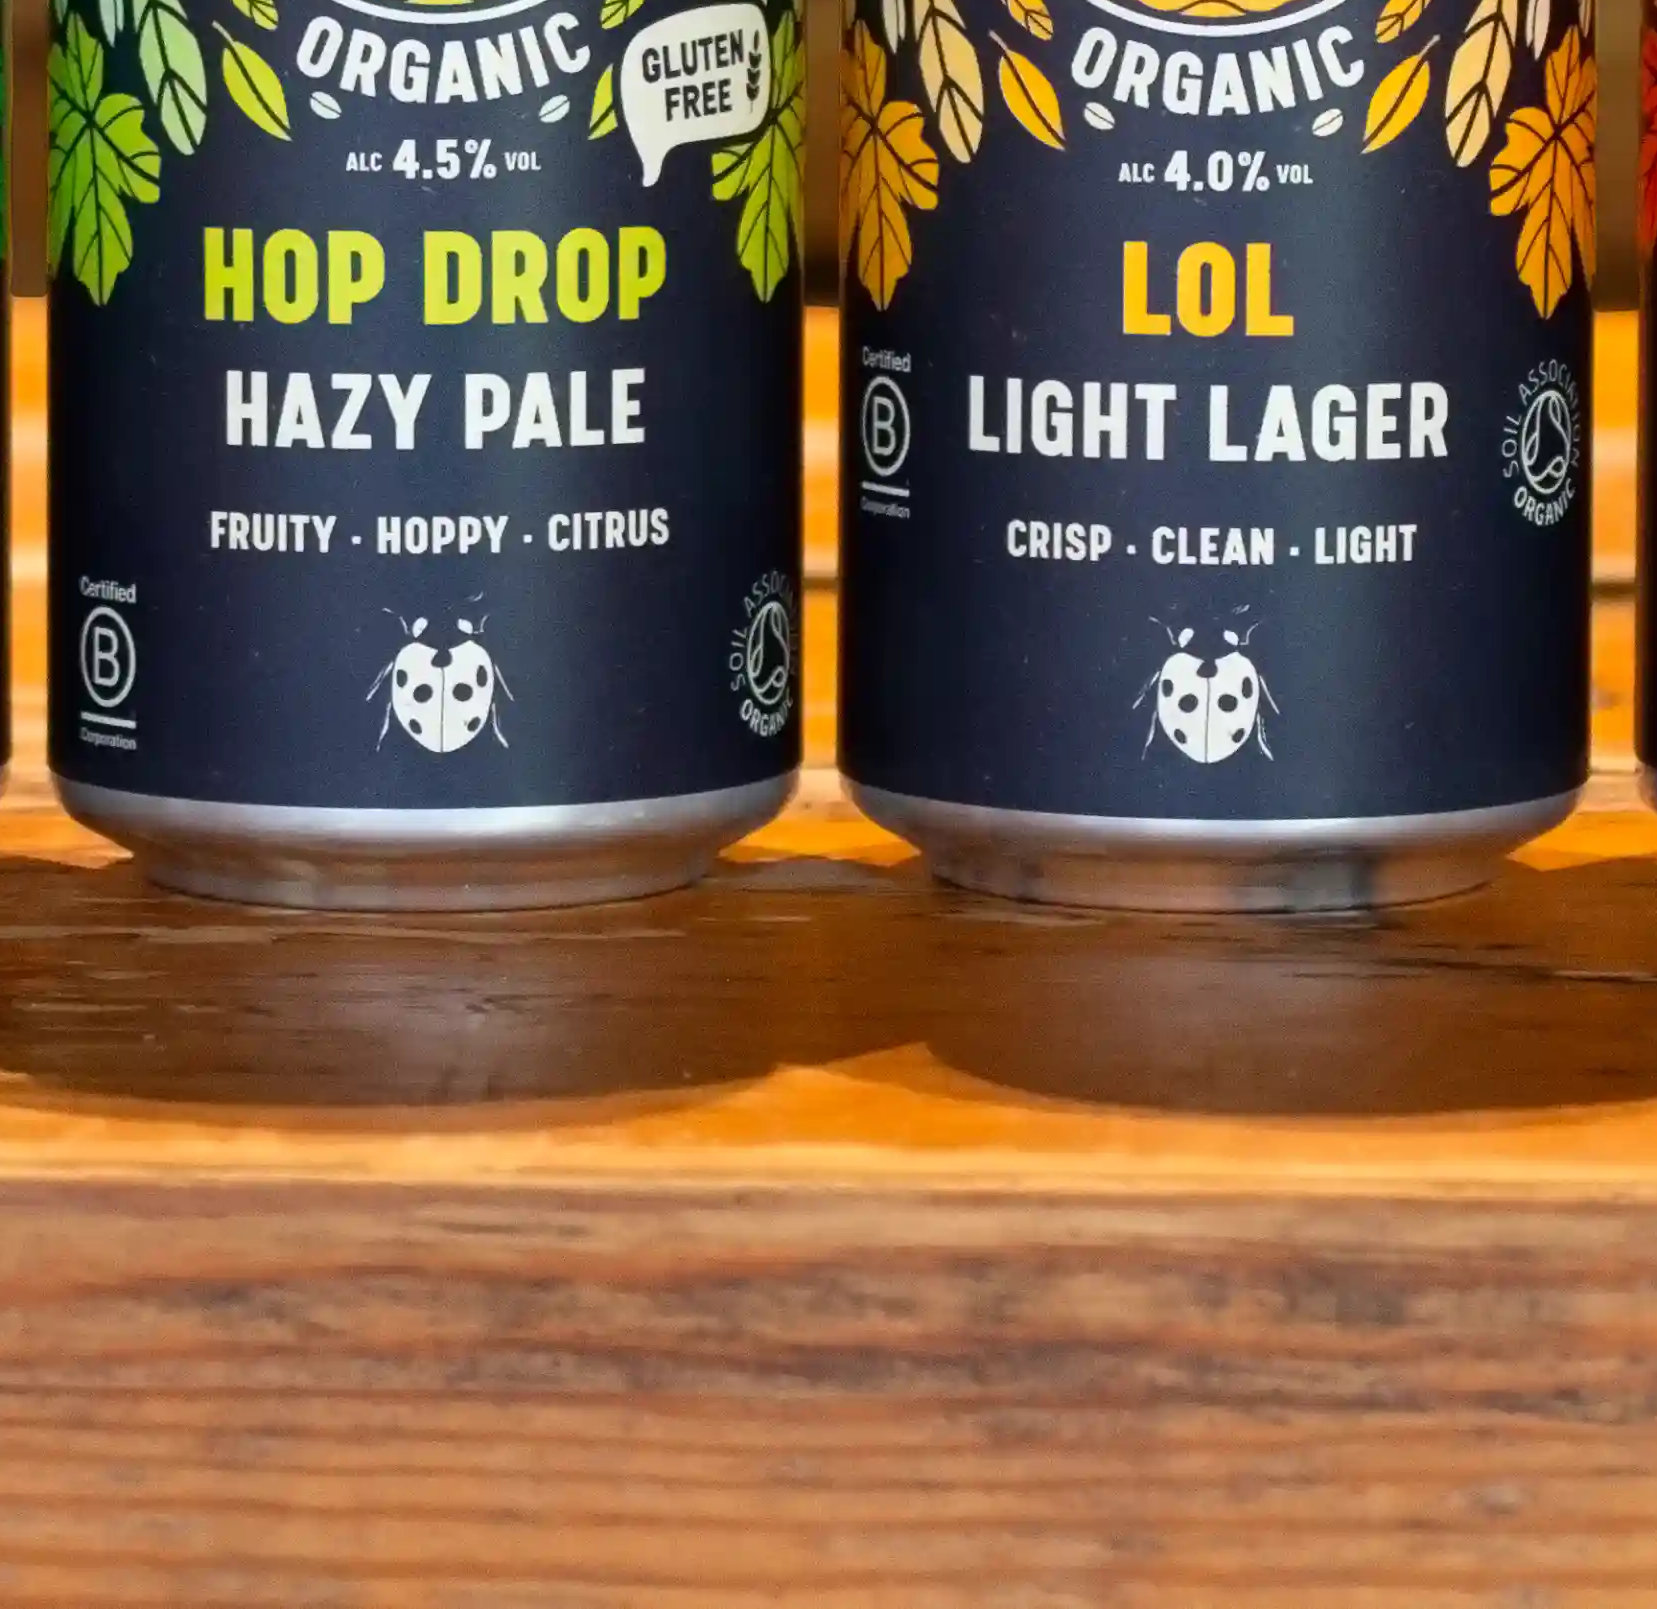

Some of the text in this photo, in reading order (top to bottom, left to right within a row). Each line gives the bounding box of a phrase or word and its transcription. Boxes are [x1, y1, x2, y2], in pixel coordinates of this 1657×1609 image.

[296, 11, 591, 104] ORGANIC
[641, 28, 744, 84] GLUTEN
[1071, 25, 1365, 117] ORGANIC
[664, 78, 733, 122] FREE
[345, 138, 542, 180] ALC 4.5% VOL
[1118, 150, 1314, 192] ALC 4.0% VOL
[204, 226, 666, 326] HOP DROP
[1122, 240, 1295, 337] LOL
[862, 345, 912, 373] Certified
[226, 367, 645, 450] HAZY PALE
[969, 375, 1449, 462] LIGHT LAGER
[1501, 415, 1521, 478] SOIL
[1514, 477, 1576, 525] ORGANIC
[210, 507, 670, 555] FRUITY HOPPY CITRUS
[1007, 519, 1418, 566] CRISP CLEAN LIGHT
[79, 575, 137, 604] Certified
[729, 627, 748, 691] SOIL
